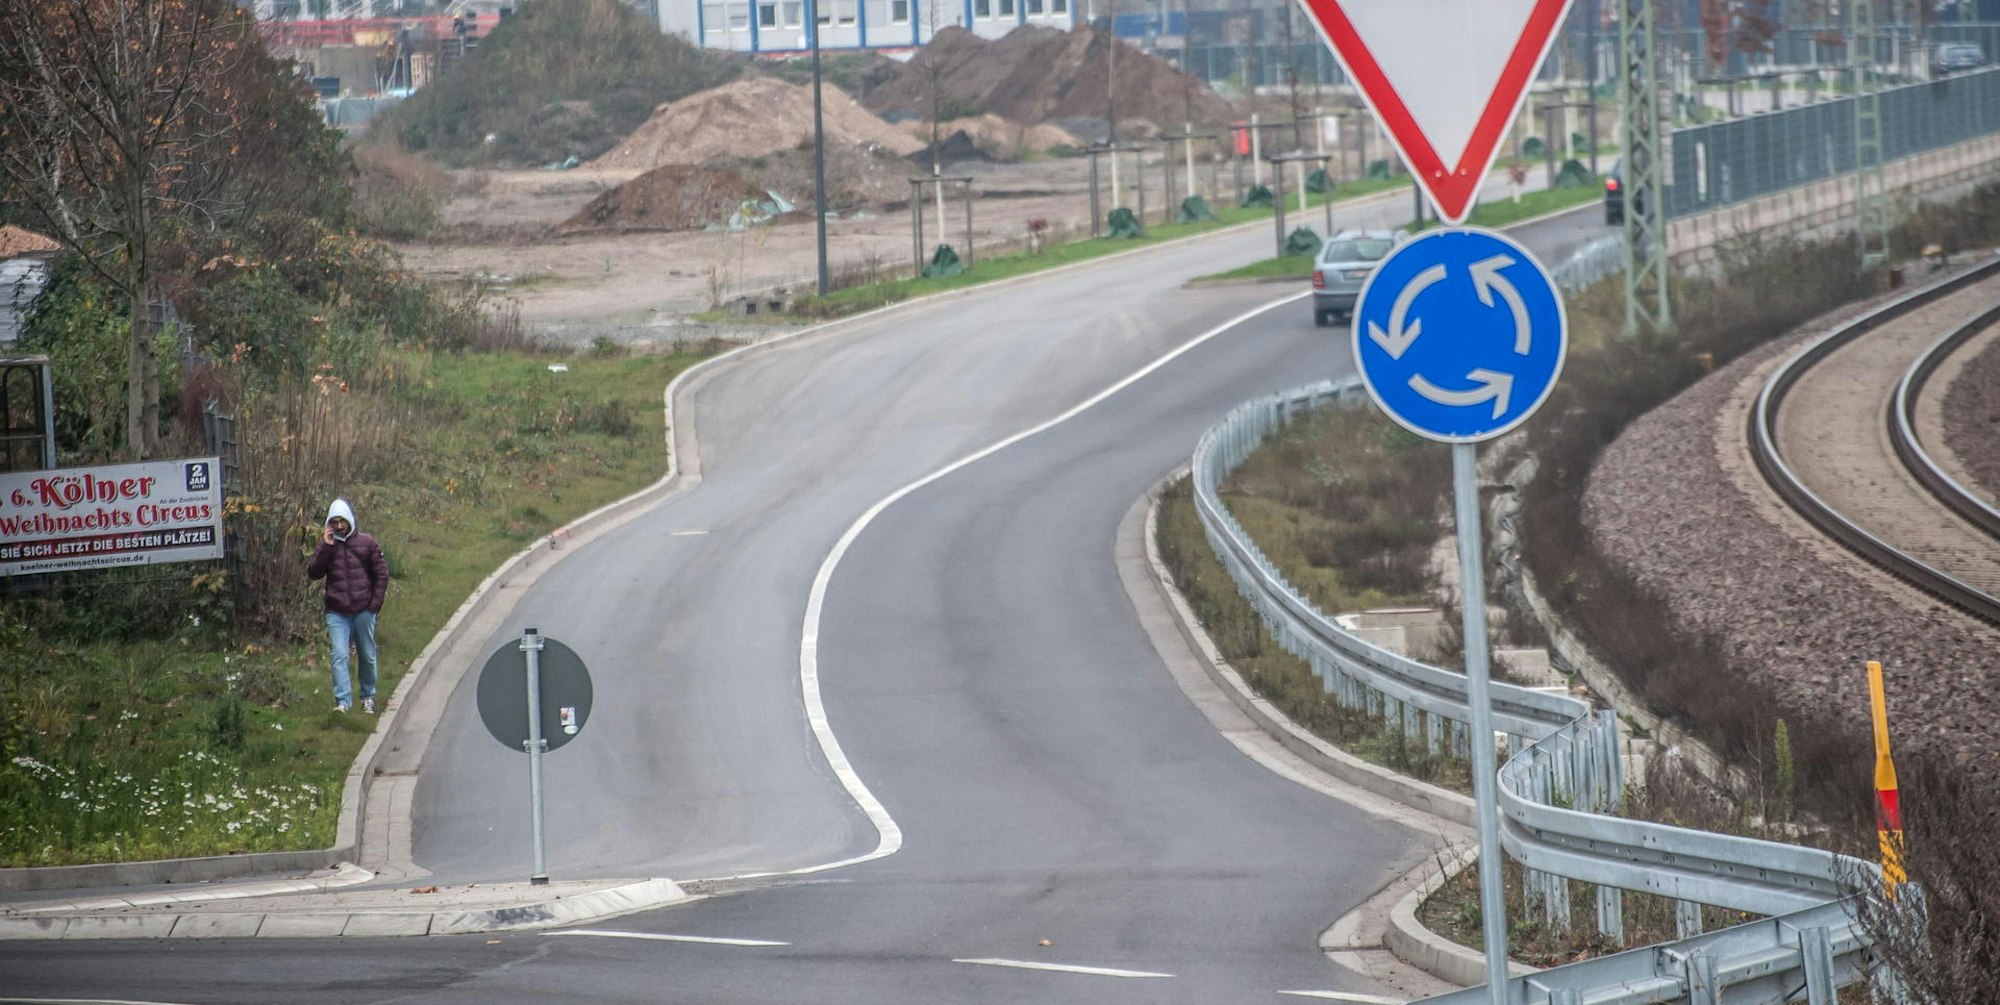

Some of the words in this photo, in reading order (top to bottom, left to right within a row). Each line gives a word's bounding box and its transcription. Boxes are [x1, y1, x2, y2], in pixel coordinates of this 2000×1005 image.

[189, 476, 206, 485] JAN
[191, 464, 203, 477] 2
[11, 488, 34, 507] 6.
[30, 472, 156, 510] Kölner
[0, 507, 132, 537] Weihnachts
[136, 503, 213, 529] Circus
[0, 547, 21, 559] SIE
[23, 544, 52, 557] SICH
[54, 541, 91, 554] JETZT
[93, 539, 113, 551] DIE
[116, 535, 162, 549] BESTEN
[164, 529, 211, 545] PLÄTZE!
[20, 554, 144, 571] koelner-weihnachtscircus.de
